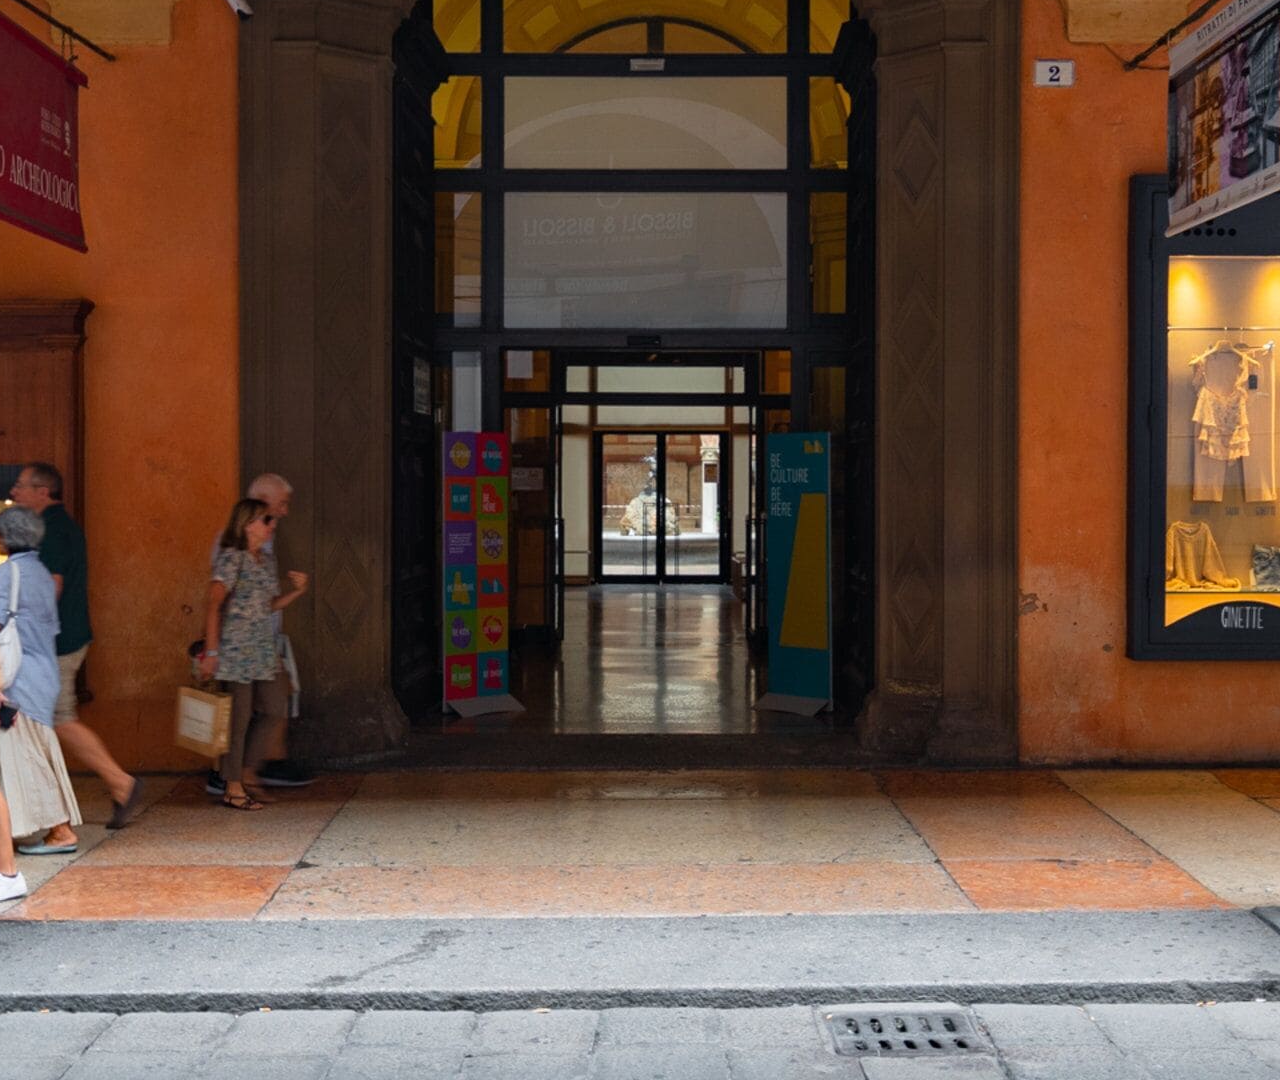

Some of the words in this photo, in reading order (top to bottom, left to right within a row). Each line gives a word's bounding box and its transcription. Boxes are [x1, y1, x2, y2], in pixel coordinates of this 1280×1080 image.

[1196, 11, 1227, 41] RITRATTI
[1228, 2, 1237, 17] DI
[1048, 65, 1061, 83] 2
[769, 453, 781, 469] BE
[769, 468, 809, 484] CULTURE
[770, 486, 781, 502] BE
[770, 502, 793, 517] HERE
[1220, 605, 1265, 629] GINETTE
